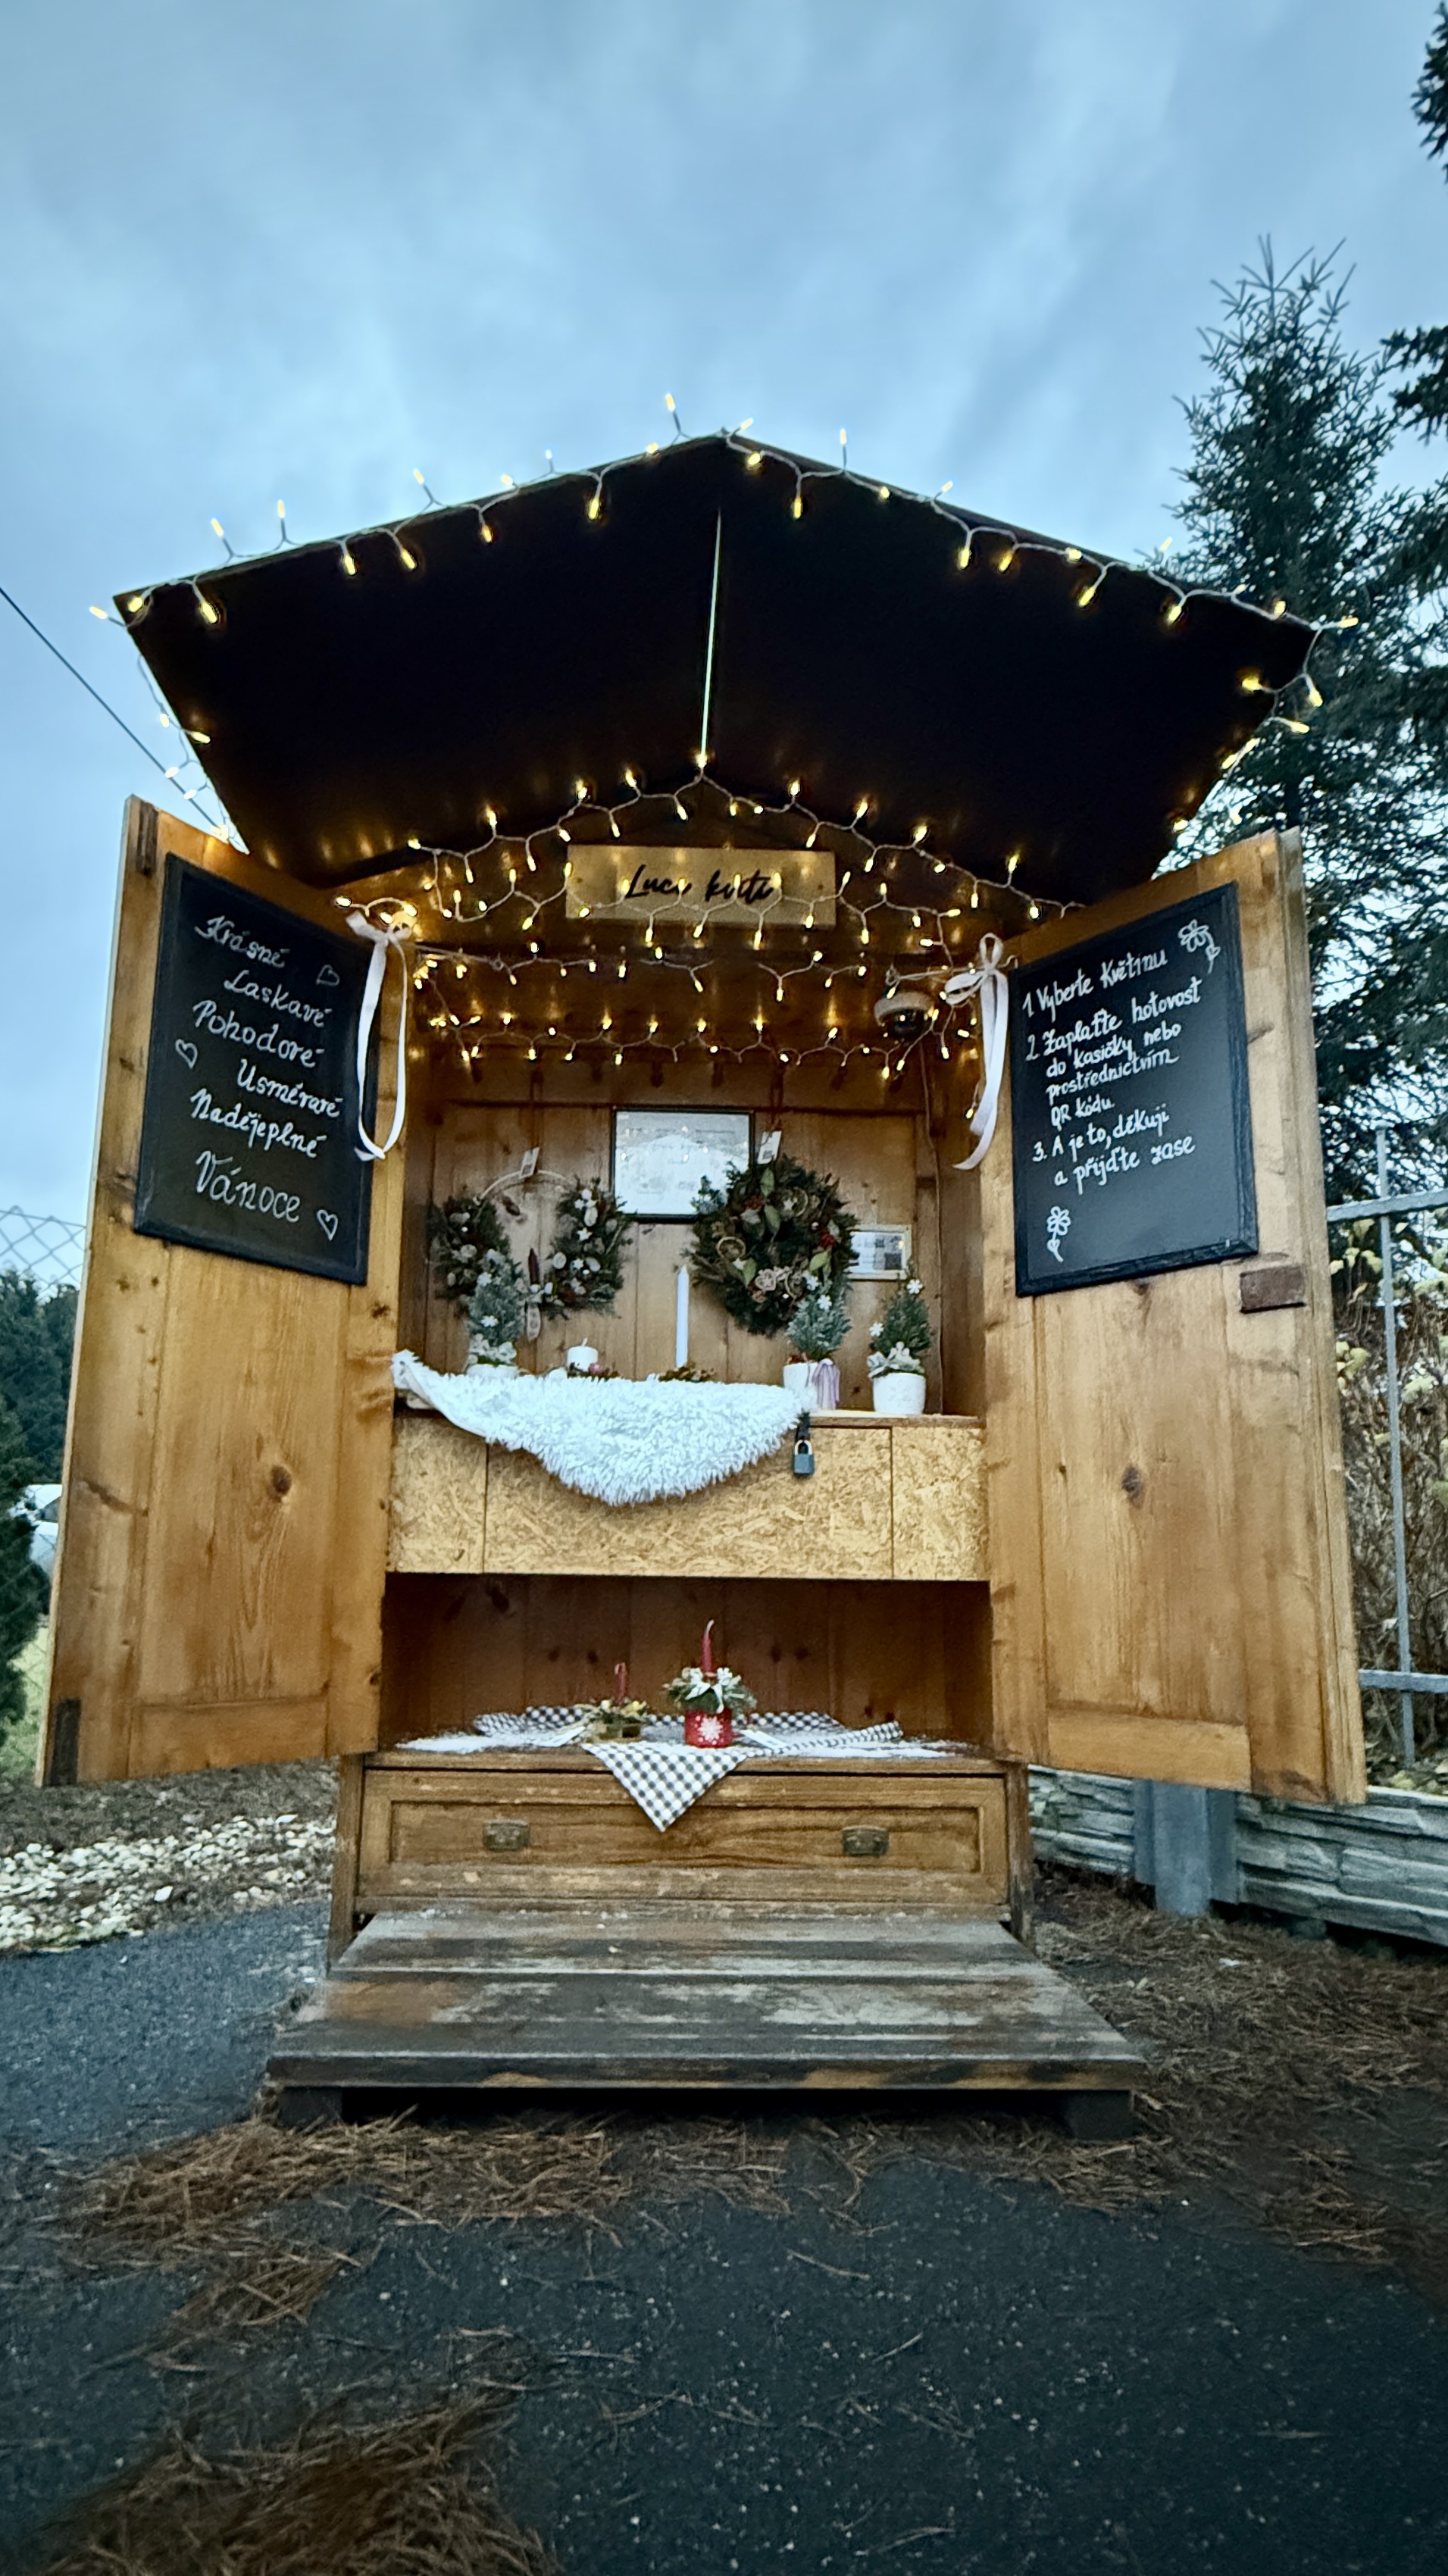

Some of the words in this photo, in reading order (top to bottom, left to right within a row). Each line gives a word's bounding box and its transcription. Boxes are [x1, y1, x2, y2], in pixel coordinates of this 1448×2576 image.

[194, 915, 291, 968] Krásné
[224, 970, 333, 1028] Laskavé
[1036, 967, 1094, 1023] Vyberte
[1131, 976, 1202, 1024] hotovost
[192, 999, 325, 1068] Pohodové
[1046, 1057, 1067, 1078] do
[1143, 1020, 1182, 1046] nebo
[1045, 1047, 1180, 1106] prostřednictvím
[190, 1088, 327, 1158] Nadějeplné
[1032, 1141, 1048, 1162] 3.
[1052, 1135, 1065, 1158] A
[1068, 1133, 1084, 1163] je
[1087, 1122, 1112, 1150] to,
[1051, 1103, 1072, 1131] QR
[195, 1150, 301, 1223] Vánoce
[1054, 1171, 1068, 1186] a
[1150, 1136, 1196, 1165] zase
